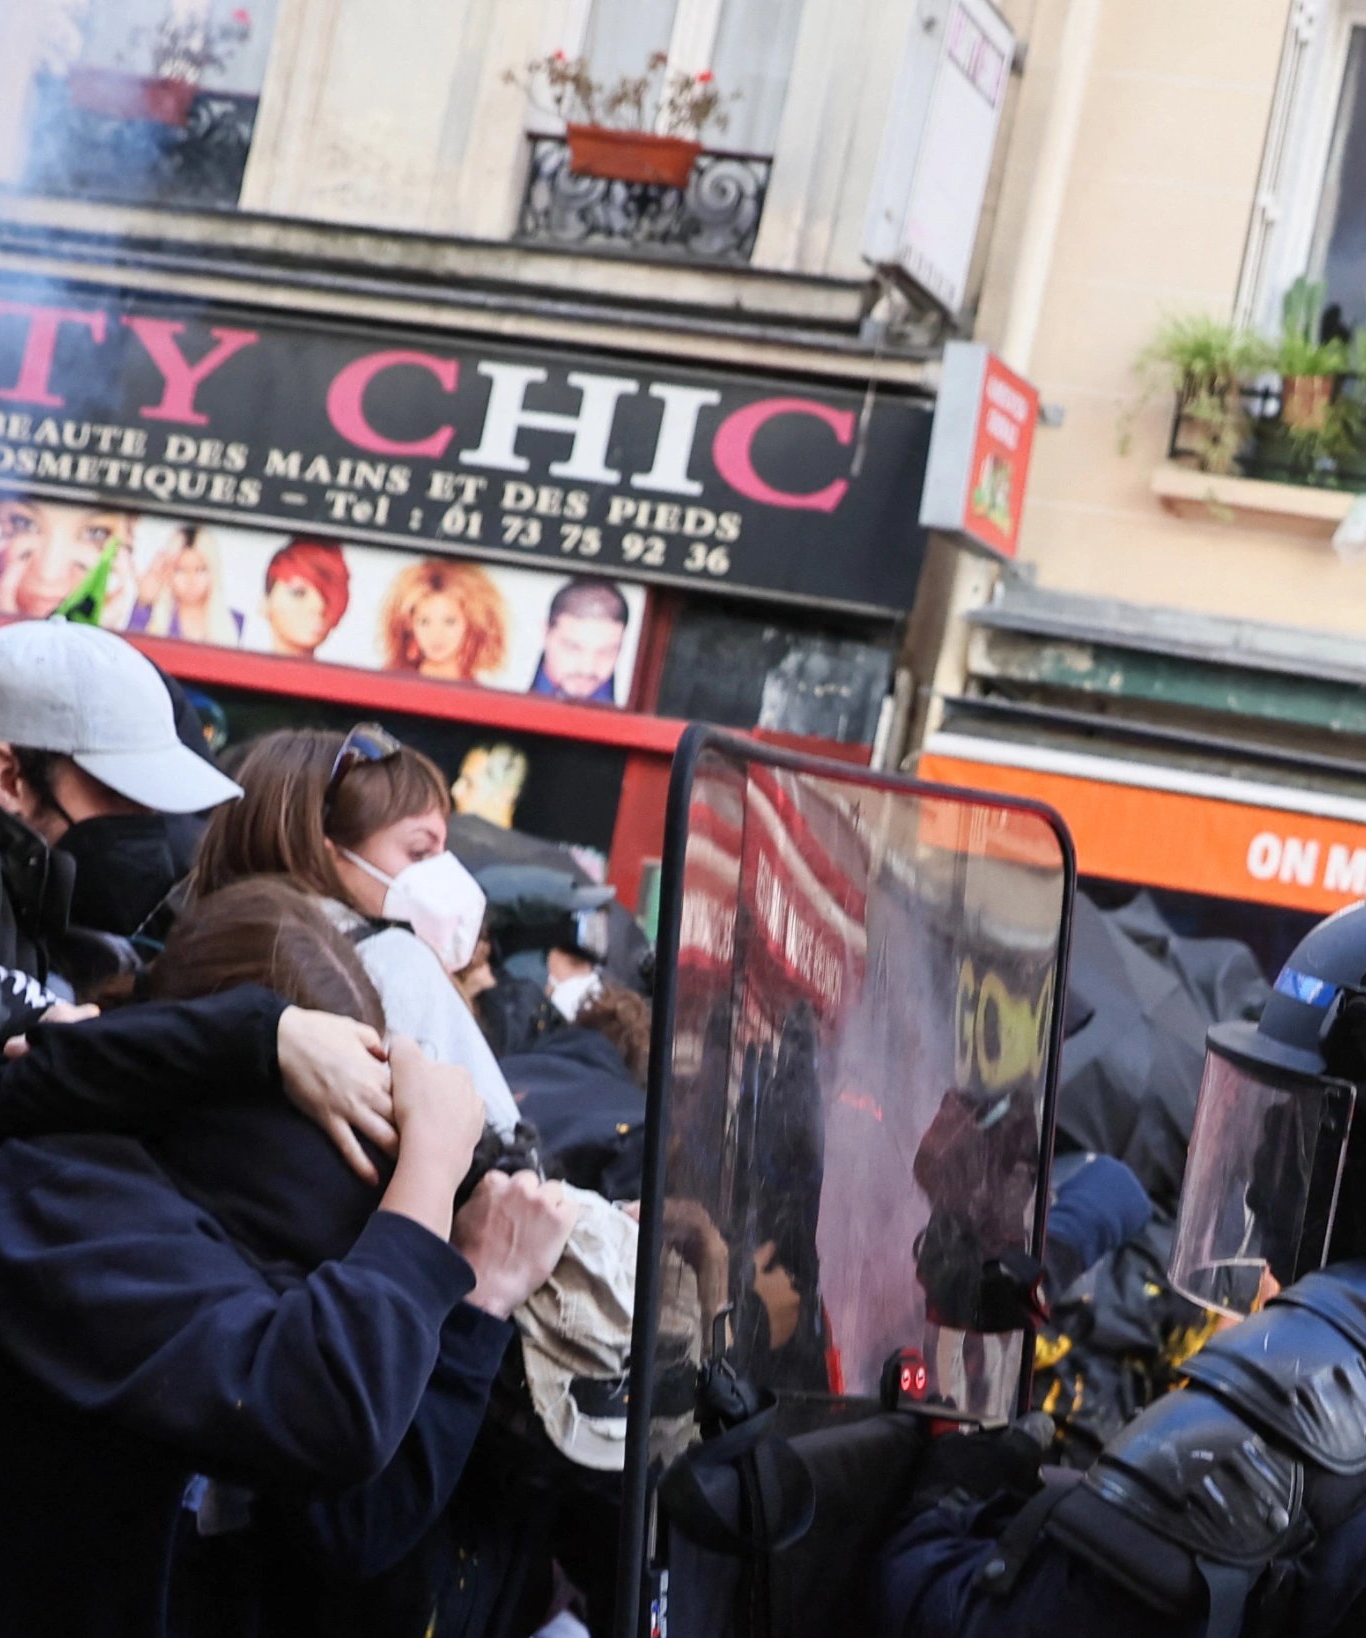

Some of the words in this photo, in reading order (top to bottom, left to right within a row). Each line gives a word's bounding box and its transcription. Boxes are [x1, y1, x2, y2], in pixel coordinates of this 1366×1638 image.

[325, 347, 857, 513] CHIC
[164, 433, 249, 473] DES
[264, 448, 412, 495] MAINS
[426, 470, 488, 505] ET
[500, 480, 590, 520] DES
[606, 495, 742, 543] PIEDS
[325, 488, 391, 526] Tel
[442, 508, 483, 540] 01
[501, 514, 542, 547] 73
[560, 522, 602, 556] 75
[621, 532, 667, 567] 92
[683, 541, 731, 576] 36
[1245, 832, 1320, 887] ON
